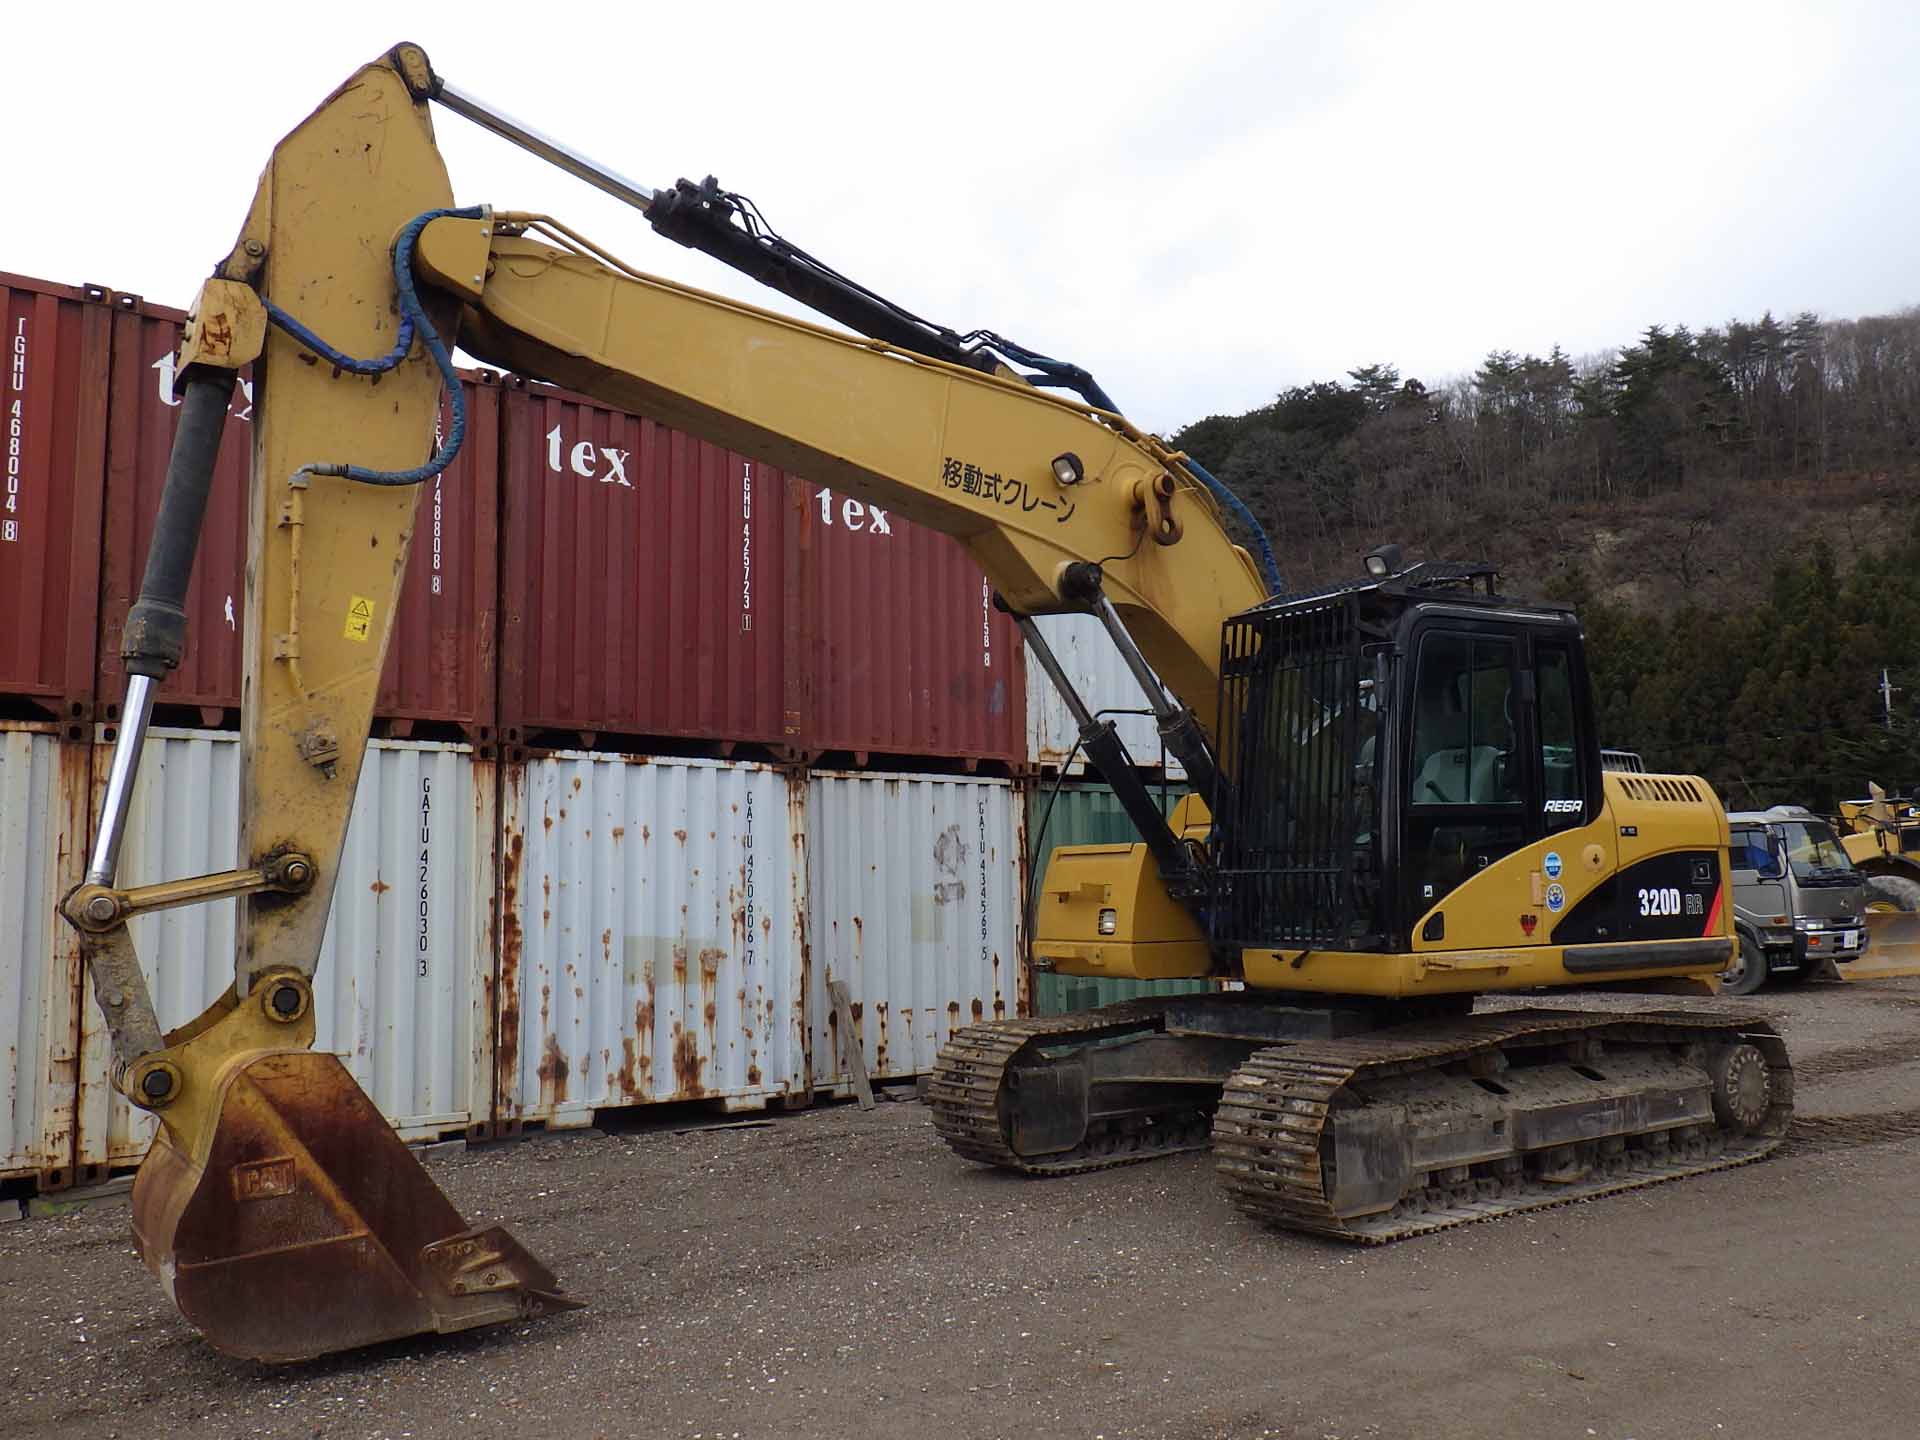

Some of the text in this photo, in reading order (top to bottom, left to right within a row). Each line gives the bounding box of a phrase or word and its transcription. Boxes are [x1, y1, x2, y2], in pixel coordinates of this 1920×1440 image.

[4, 317, 27, 541] TGHU 468004 8
[546, 424, 632, 487] tex
[743, 463, 751, 519] TGHU
[815, 488, 892, 535] tex
[942, 457, 1076, 523] 移動式クレーン
[422, 777, 430, 844] GATU
[419, 849, 429, 952] 426030
[979, 859, 988, 941] 434569
[1638, 888, 1681, 916] 320D
